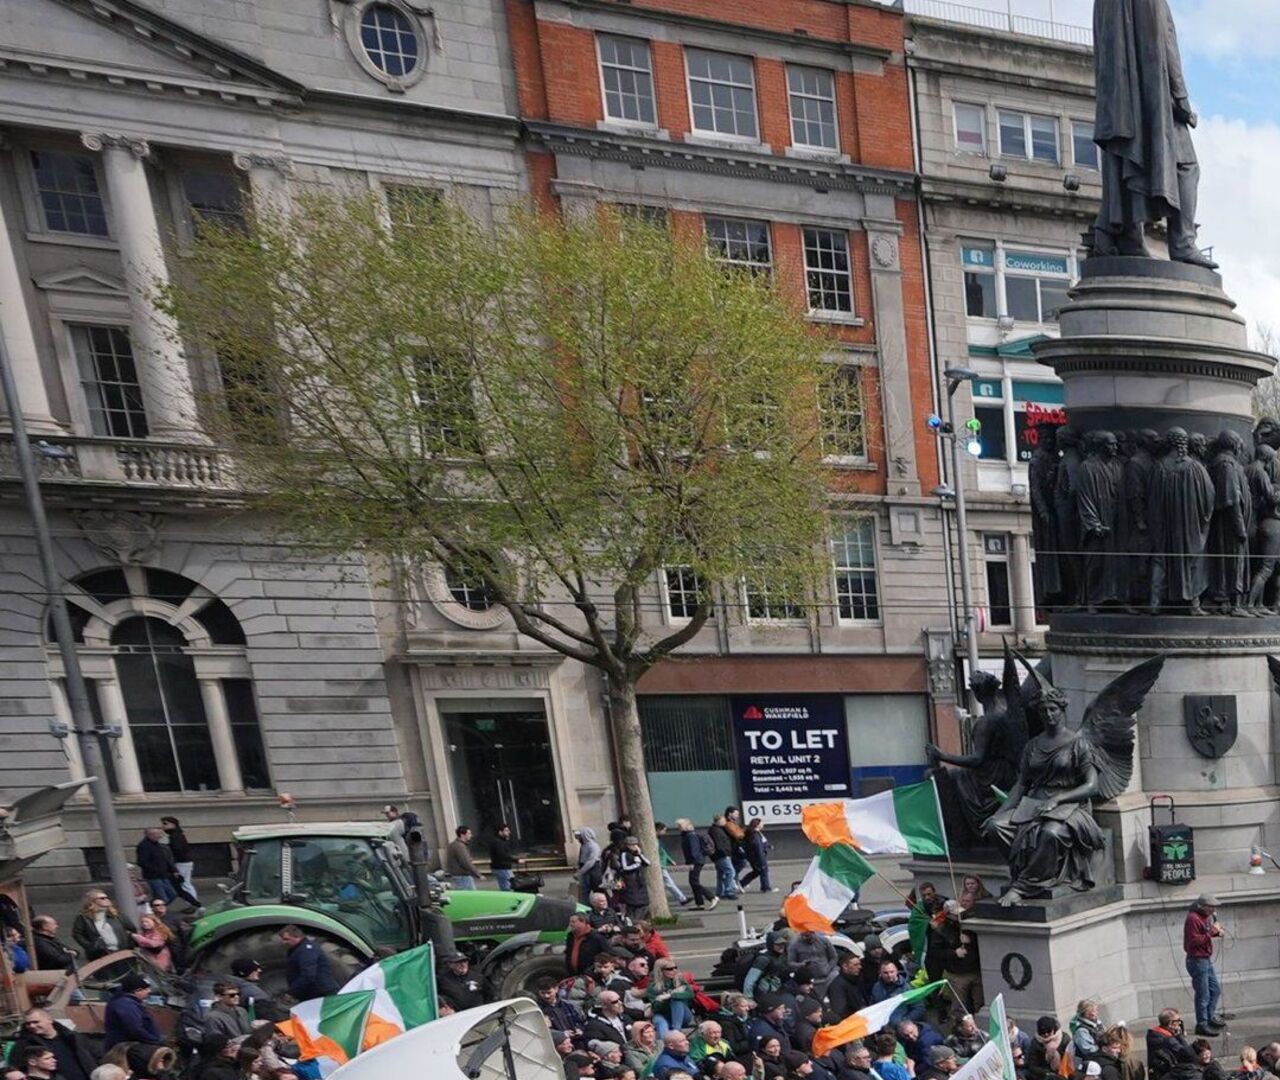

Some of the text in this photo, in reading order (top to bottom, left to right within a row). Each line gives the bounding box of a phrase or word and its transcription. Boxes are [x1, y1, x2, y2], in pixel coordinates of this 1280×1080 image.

[744, 729, 838, 750] TO LET
[750, 755, 821, 765] RETAIL UNIT 2
[748, 805, 765, 816] 01
[772, 804, 802, 816] 639
[1162, 868, 1191, 880] PEOPLE
